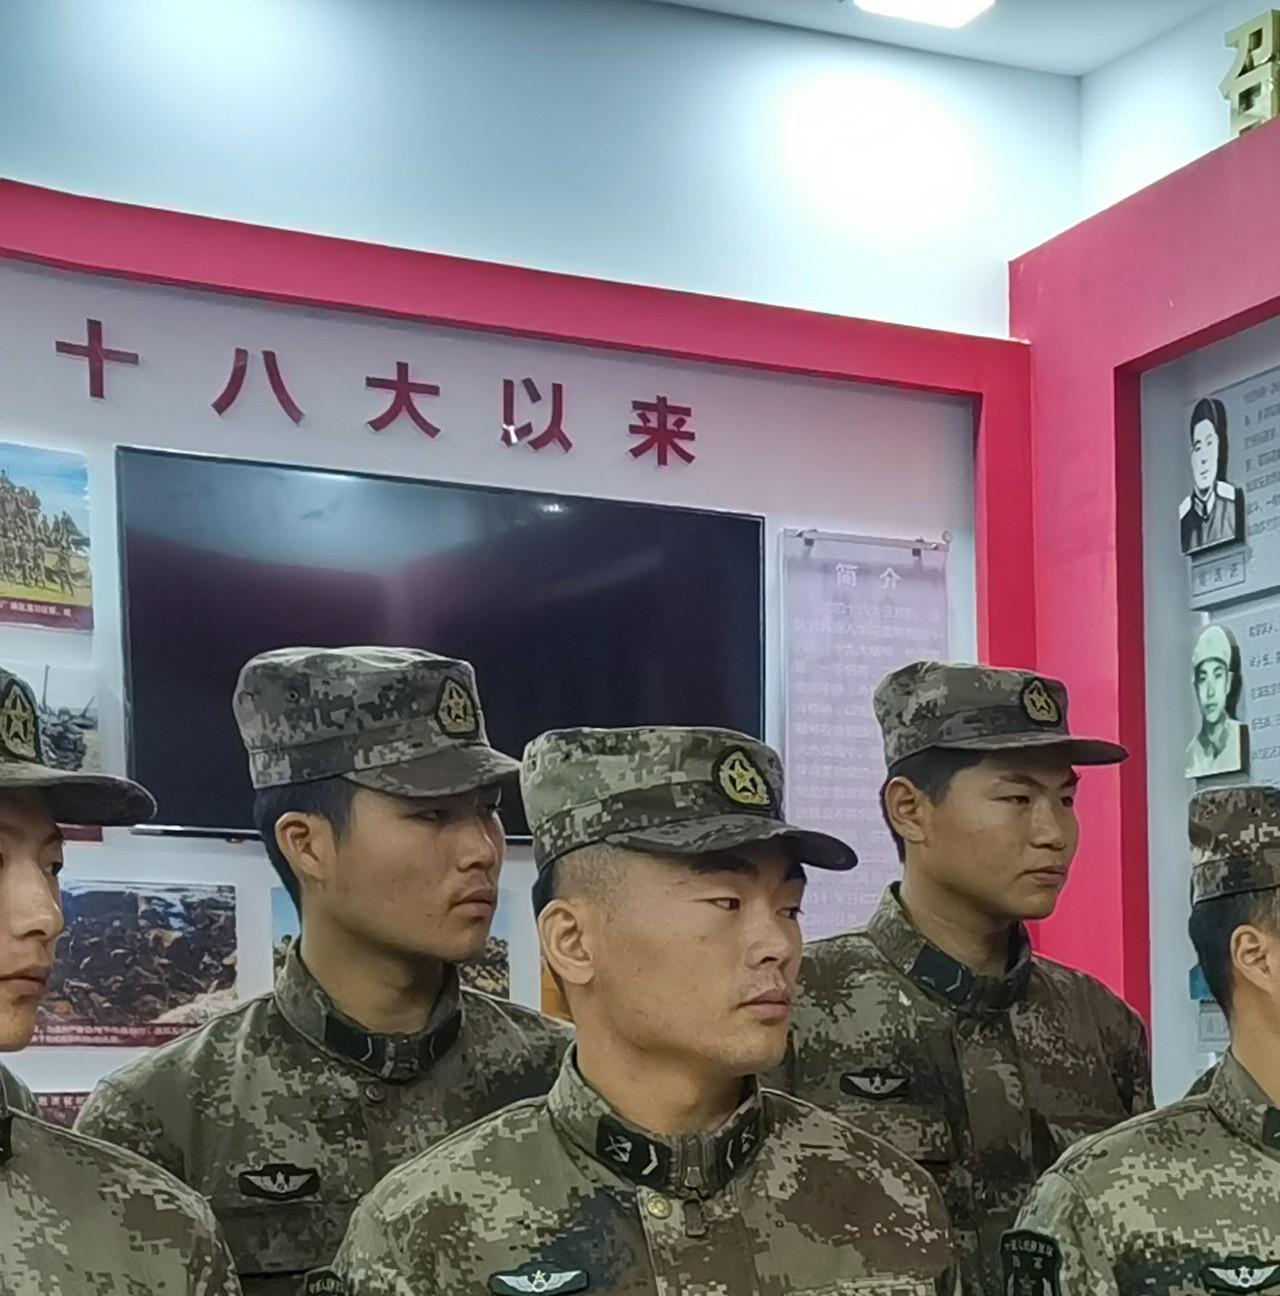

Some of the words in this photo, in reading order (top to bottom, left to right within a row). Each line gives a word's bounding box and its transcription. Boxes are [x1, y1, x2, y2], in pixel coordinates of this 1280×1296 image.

[55, 319, 699, 469] 十八大以来
[835, 562, 901, 590] 简介
